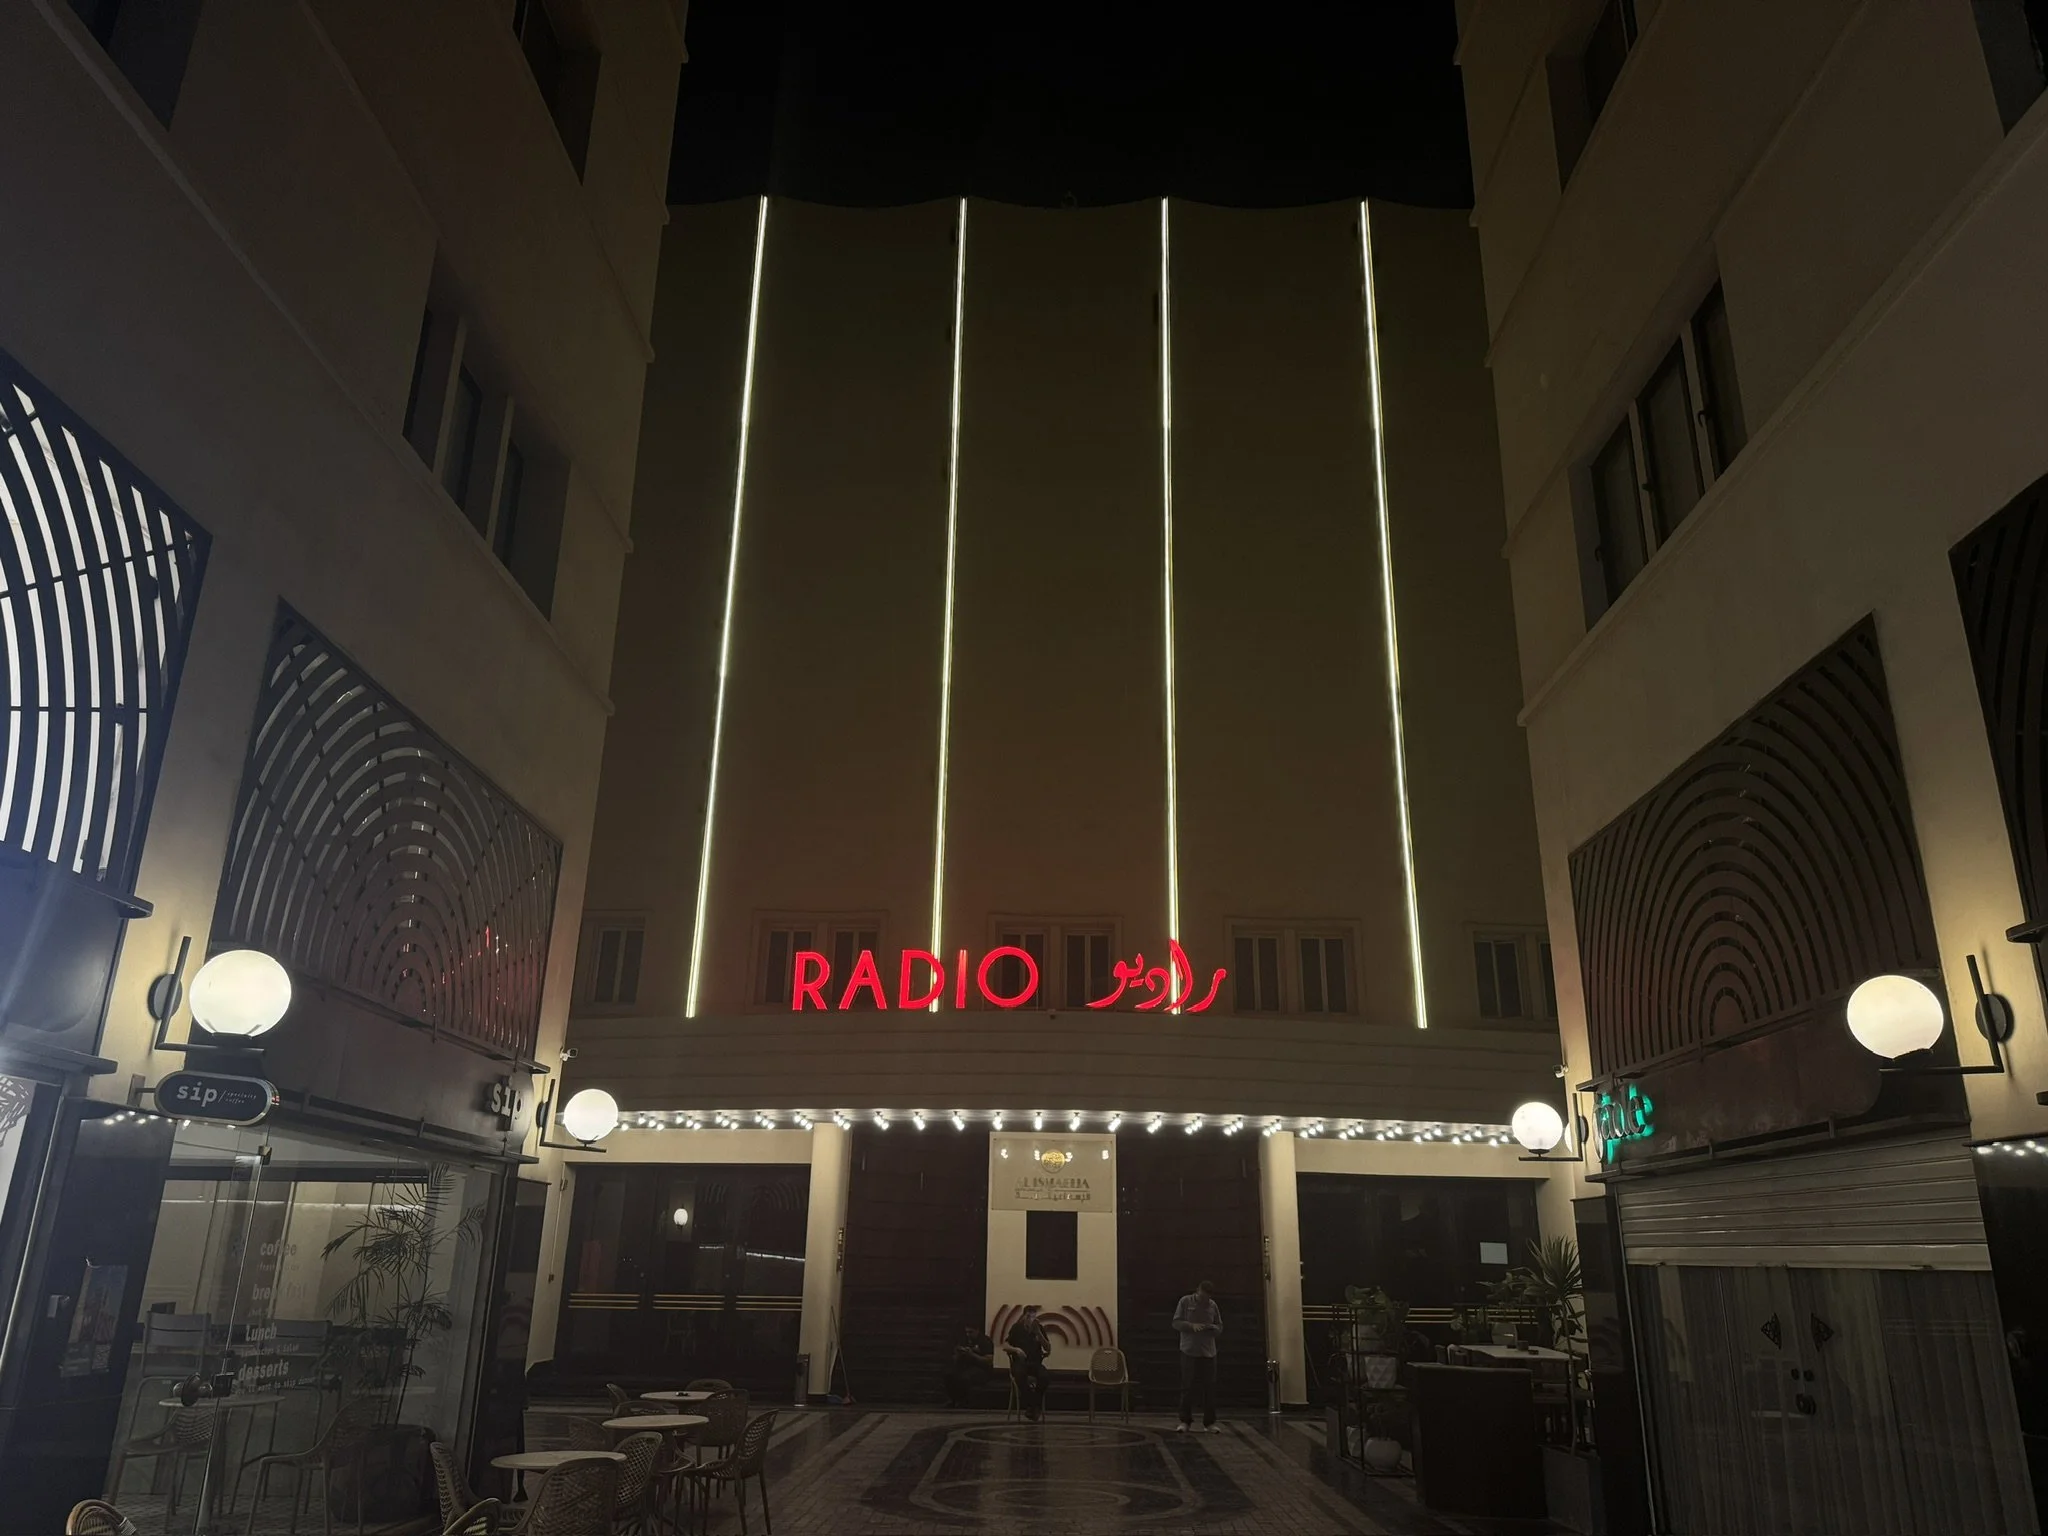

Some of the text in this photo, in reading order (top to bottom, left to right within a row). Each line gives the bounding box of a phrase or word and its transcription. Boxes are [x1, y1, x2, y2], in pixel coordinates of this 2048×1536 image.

[792, 946, 1039, 1011] RADIO
[1086, 939, 1227, 1013] راديو
[177, 1082, 218, 1107] sip
[491, 1075, 522, 1131] sip
[261, 1239, 297, 1256] cofee
[246, 1322, 278, 1341] lunch
[238, 1359, 289, 1380] desserts
